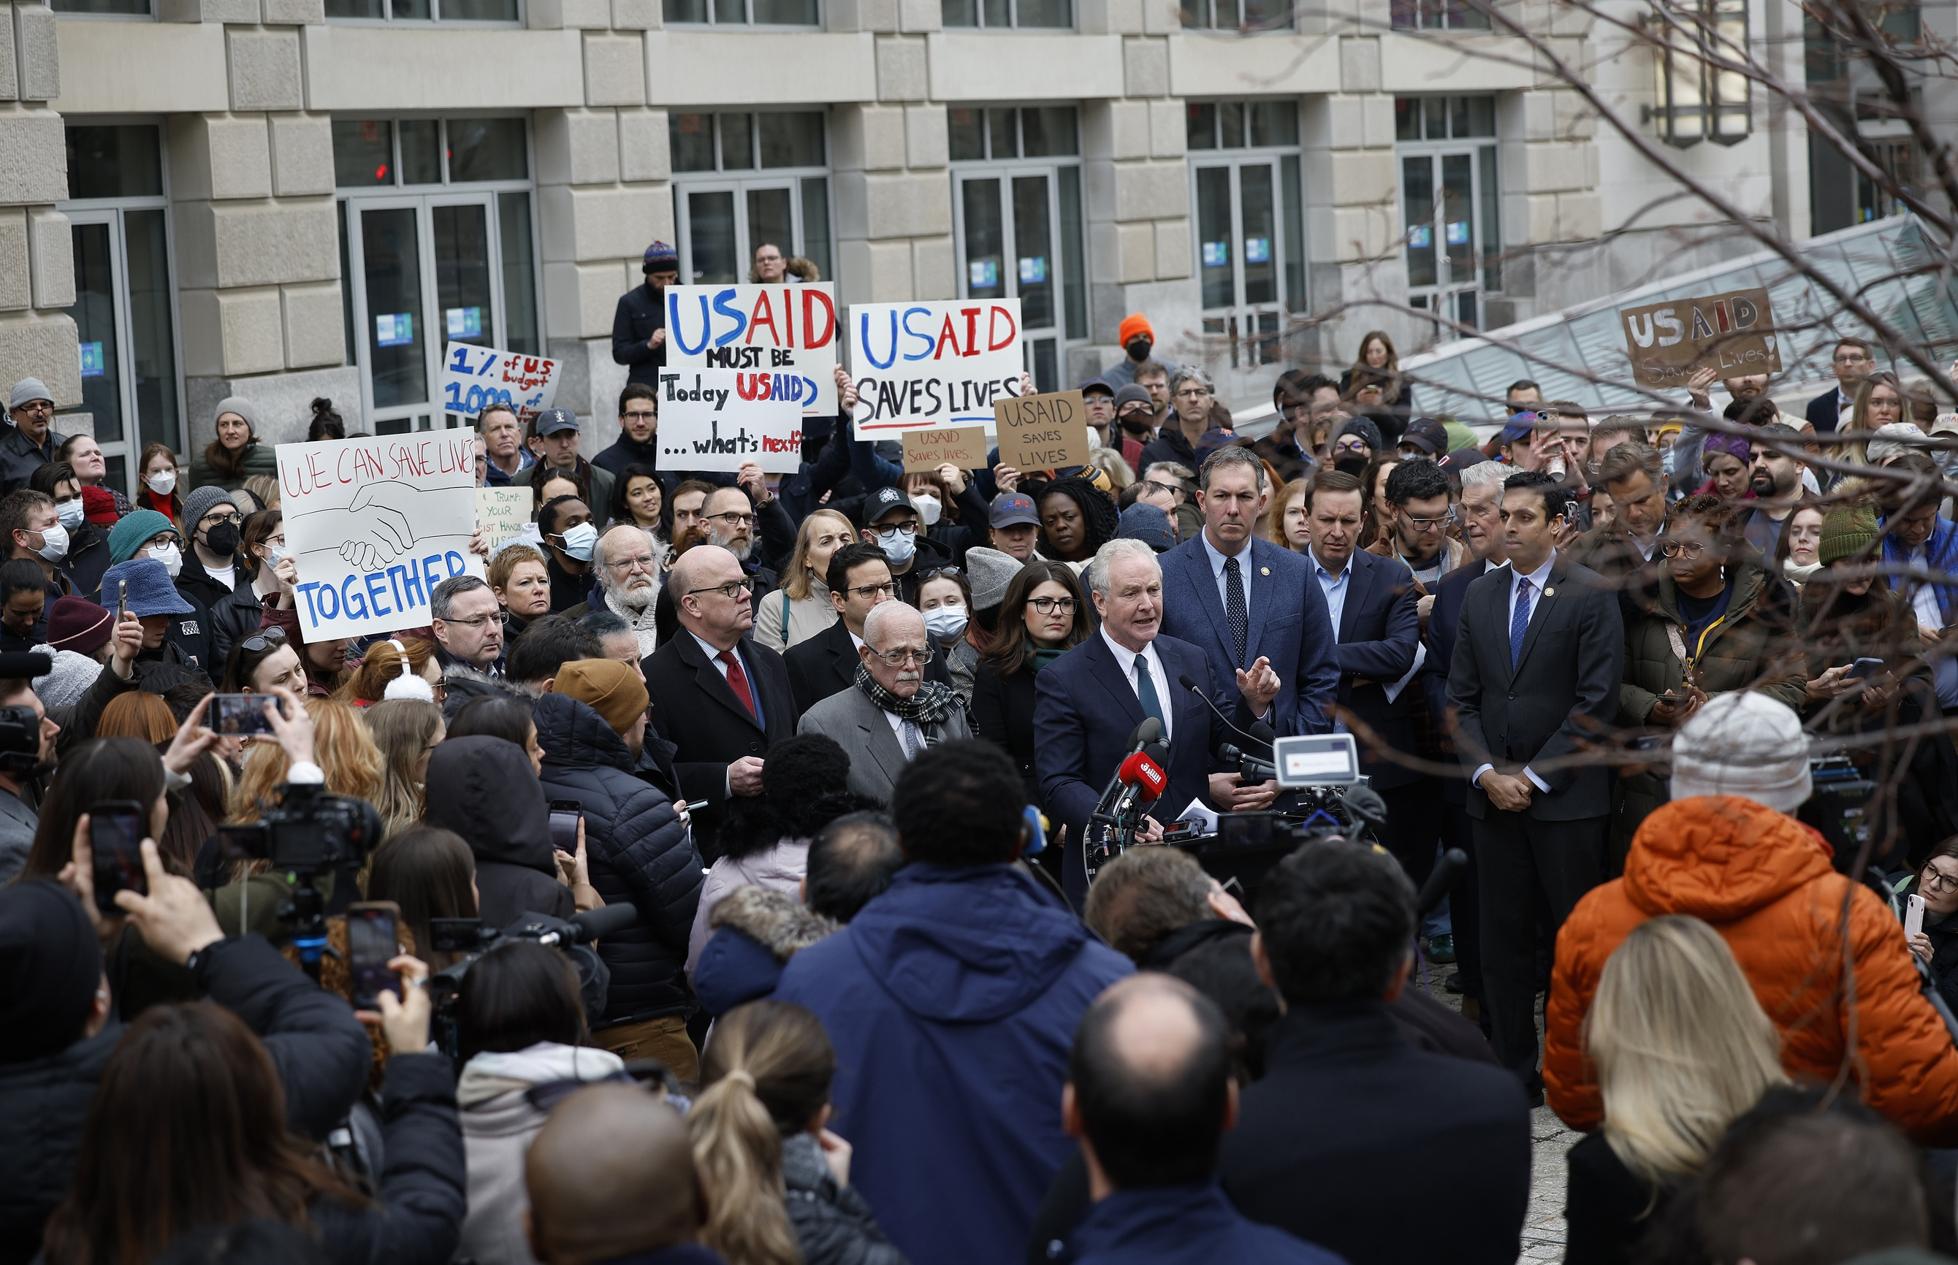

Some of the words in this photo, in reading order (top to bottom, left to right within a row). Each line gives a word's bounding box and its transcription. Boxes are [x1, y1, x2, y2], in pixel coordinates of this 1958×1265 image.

[669, 288, 835, 356] USAID
[861, 306, 1016, 370] USAID
[449, 347, 498, 375] 1%
[504, 355, 521, 370] of
[706, 346, 763, 369] MUST
[771, 349, 794, 368] BE
[502, 370, 549, 391] budget
[660, 374, 730, 411] Today
[736, 373, 803, 402] USAID
[856, 377, 942, 425] SAVES
[1003, 399, 1073, 427] USAID
[920, 430, 960, 445] USAID
[1022, 430, 1062, 444] SAVES
[907, 448, 940, 464] Saves
[1019, 449, 1068, 466] LIVES
[281, 452, 332, 498] WE
[337, 447, 384, 483] CAN
[388, 441, 435, 480] SAVE
[486, 505, 512, 517] YOUR
